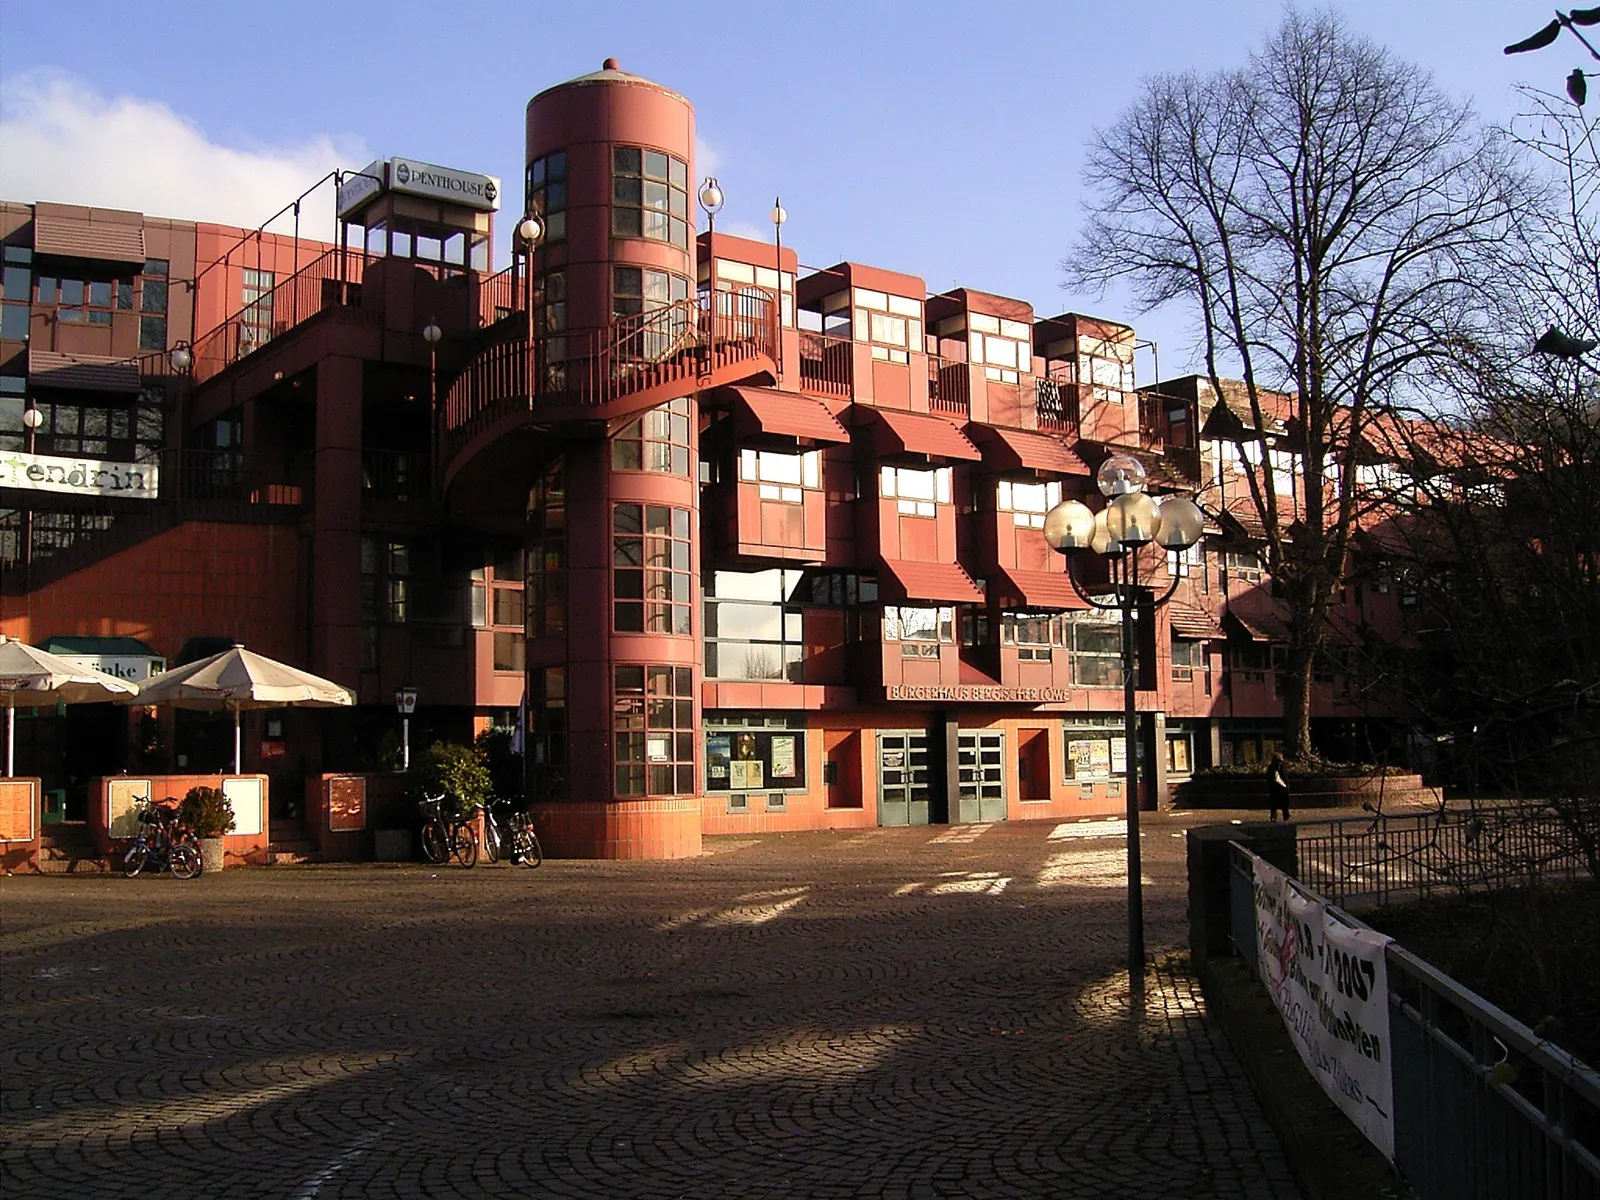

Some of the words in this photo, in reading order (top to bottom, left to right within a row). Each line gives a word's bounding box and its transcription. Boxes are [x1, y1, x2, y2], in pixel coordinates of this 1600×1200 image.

[411, 170, 484, 197] PENTHOUSE
[891, 684, 969, 699] BÜRGERHAUS
[972, 687, 1038, 700] BERGISCHER
[1039, 687, 1070, 700] LÖWE
